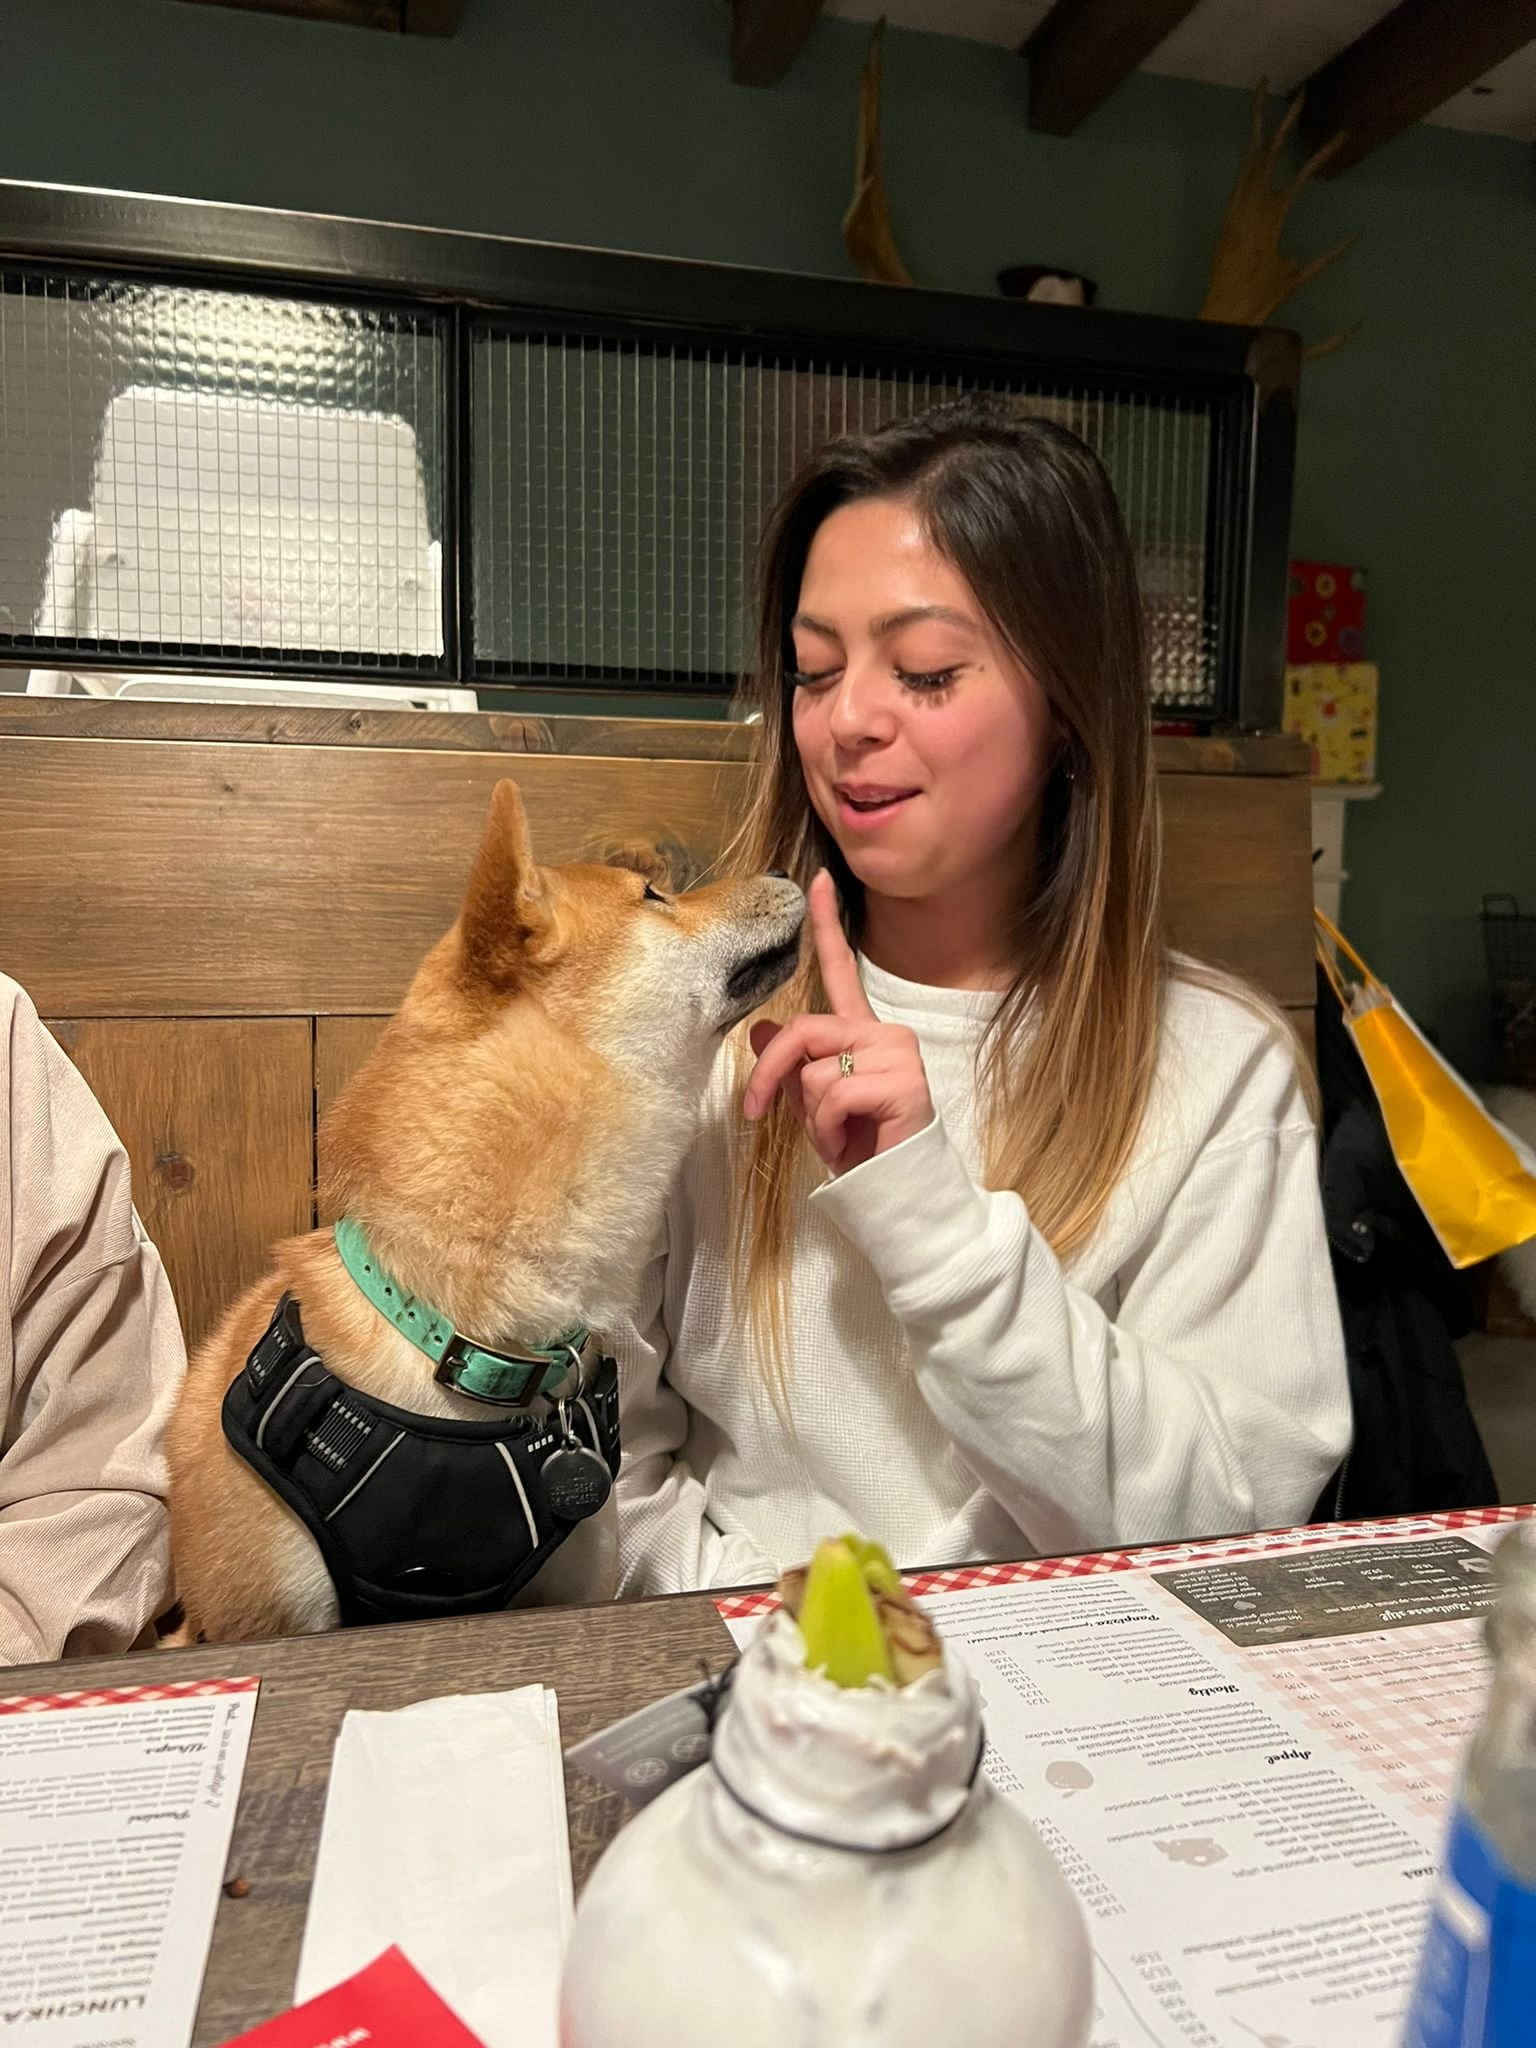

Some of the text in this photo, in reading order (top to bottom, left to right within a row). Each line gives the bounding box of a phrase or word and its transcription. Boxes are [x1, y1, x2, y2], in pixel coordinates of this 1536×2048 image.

[1096, 1615, 1160, 1627] Panpizza
[1187, 1684, 1240, 1696] Hartig
[144, 1743, 206, 1755] Wraps
[1264, 1750, 1311, 1766] Appel
